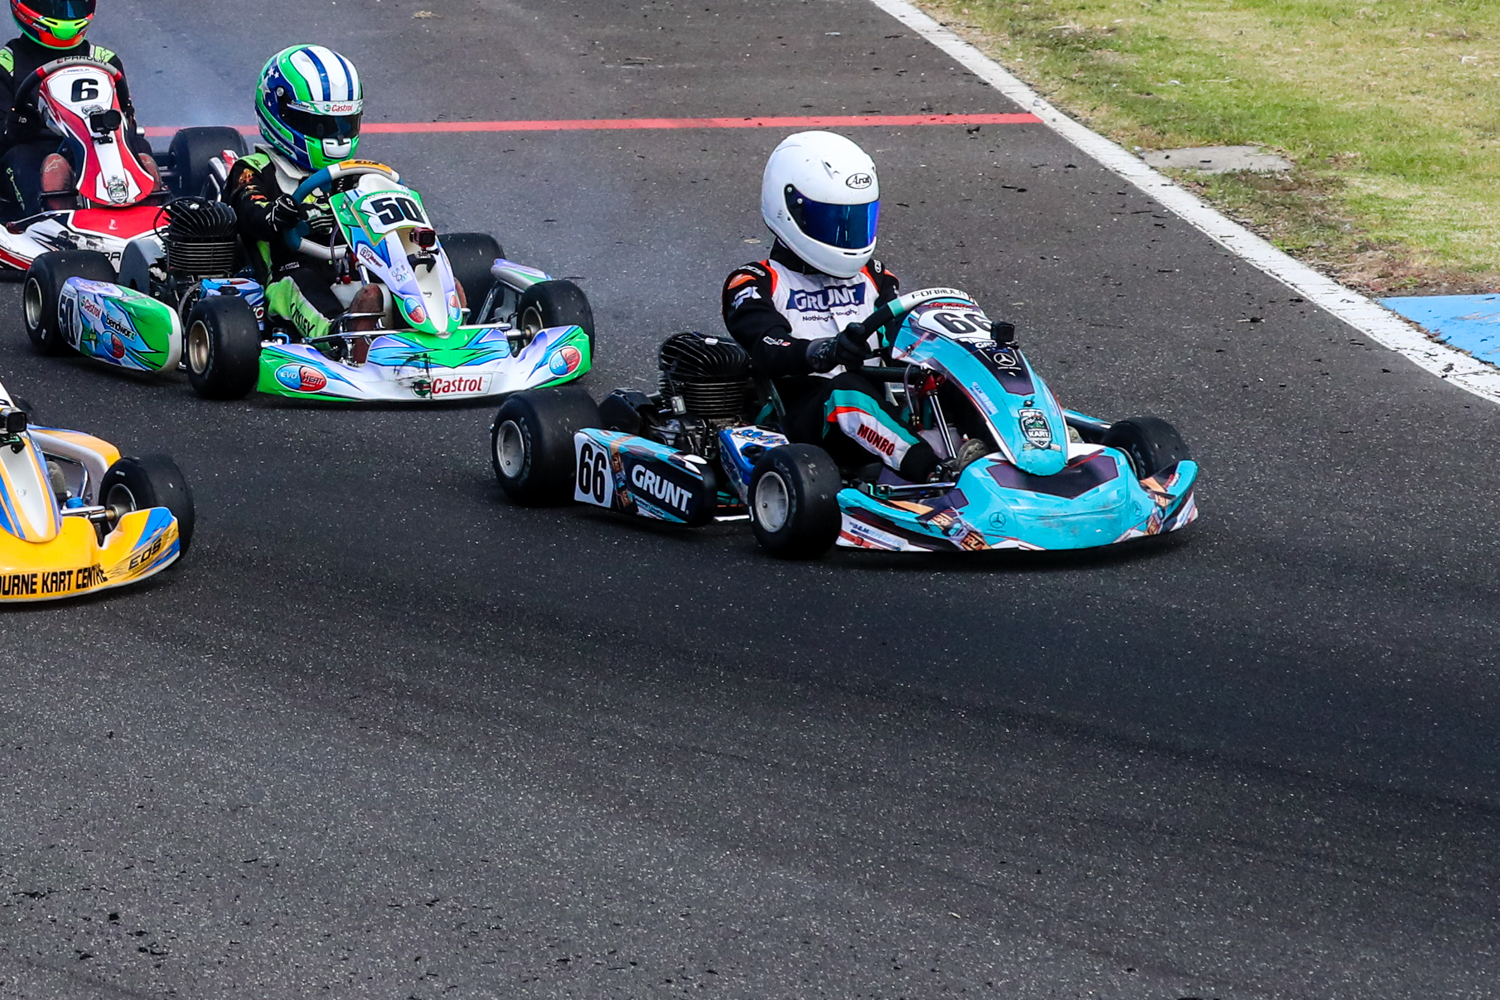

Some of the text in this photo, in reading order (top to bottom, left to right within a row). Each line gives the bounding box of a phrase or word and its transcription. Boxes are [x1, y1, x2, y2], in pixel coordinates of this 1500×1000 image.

[70, 78, 100, 103] 6
[331, 103, 354, 112] Castrol
[370, 196, 427, 226] 50
[932, 312, 993, 334] 66
[433, 375, 483, 394] Castrol
[856, 423, 896, 457] MUNRO
[578, 442, 607, 504] 66
[631, 464, 693, 514] GRUNT
[127, 537, 162, 571] EOS
[41, 570, 74, 594] KART
